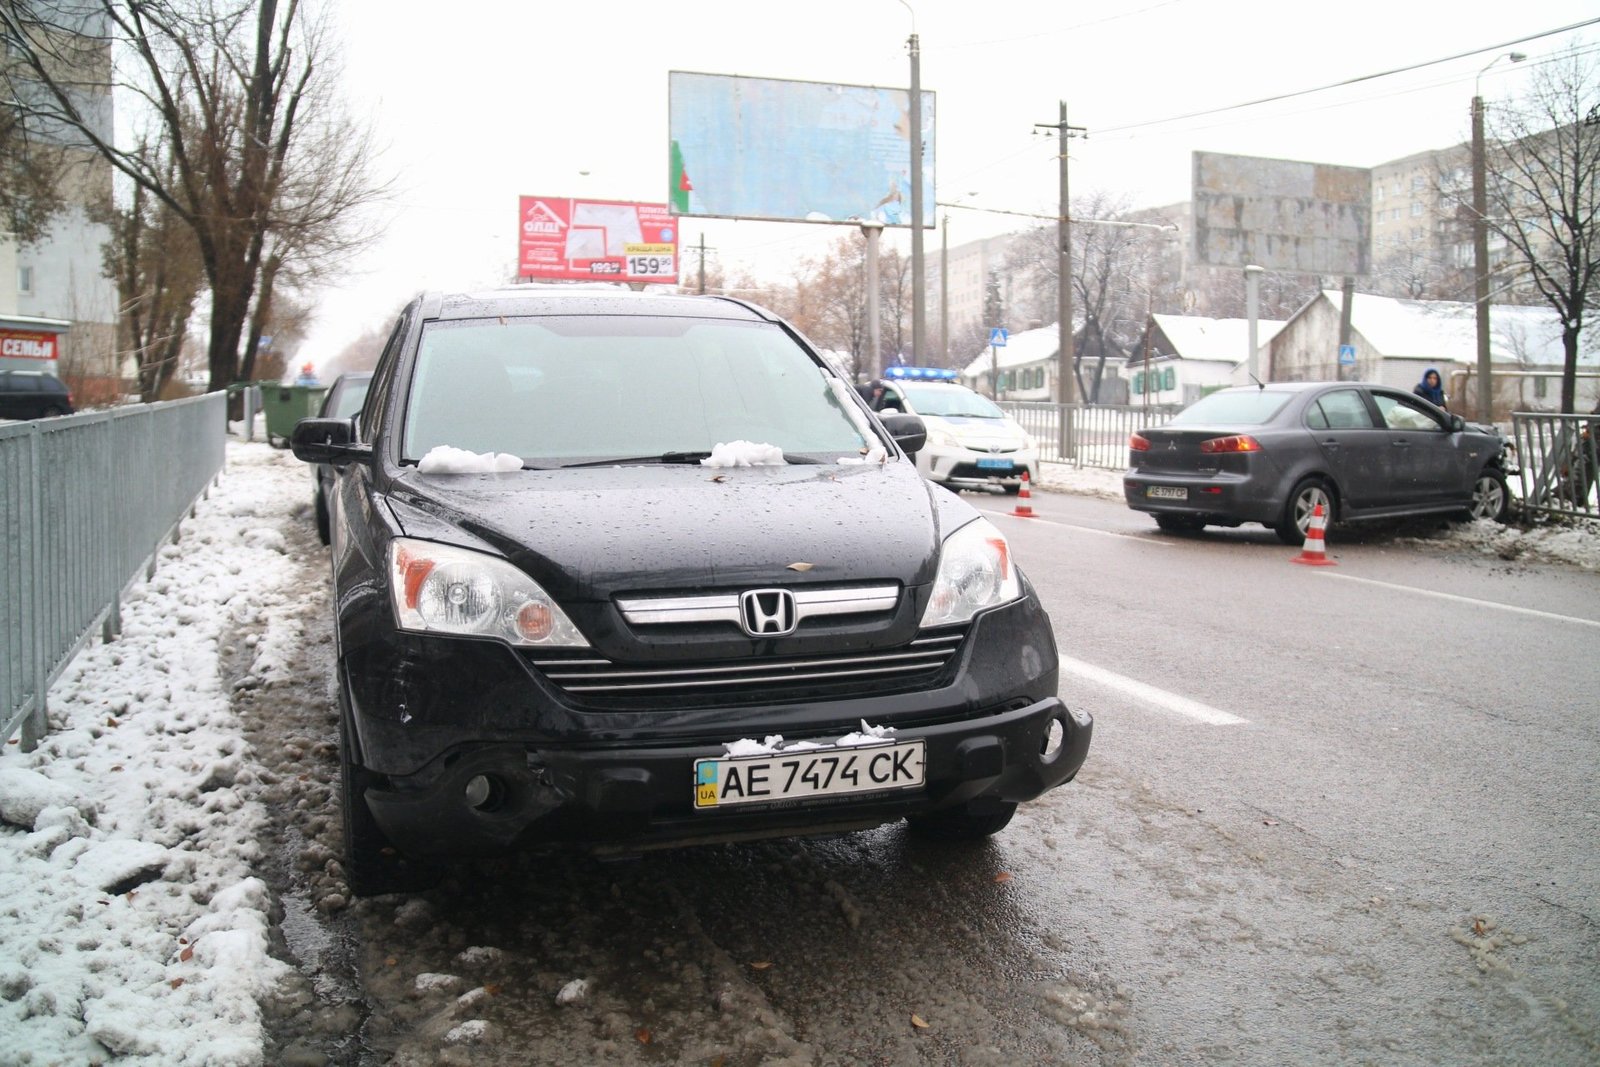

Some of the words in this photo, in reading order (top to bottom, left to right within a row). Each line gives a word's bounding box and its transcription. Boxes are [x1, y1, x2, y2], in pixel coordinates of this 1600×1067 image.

[629, 257, 660, 275] 159
[3, 339, 53, 357] СЕМЬИ
[721, 766, 770, 798] AE
[782, 756, 858, 792] 7474
[869, 748, 914, 783] CK
[700, 790, 716, 800] UA
